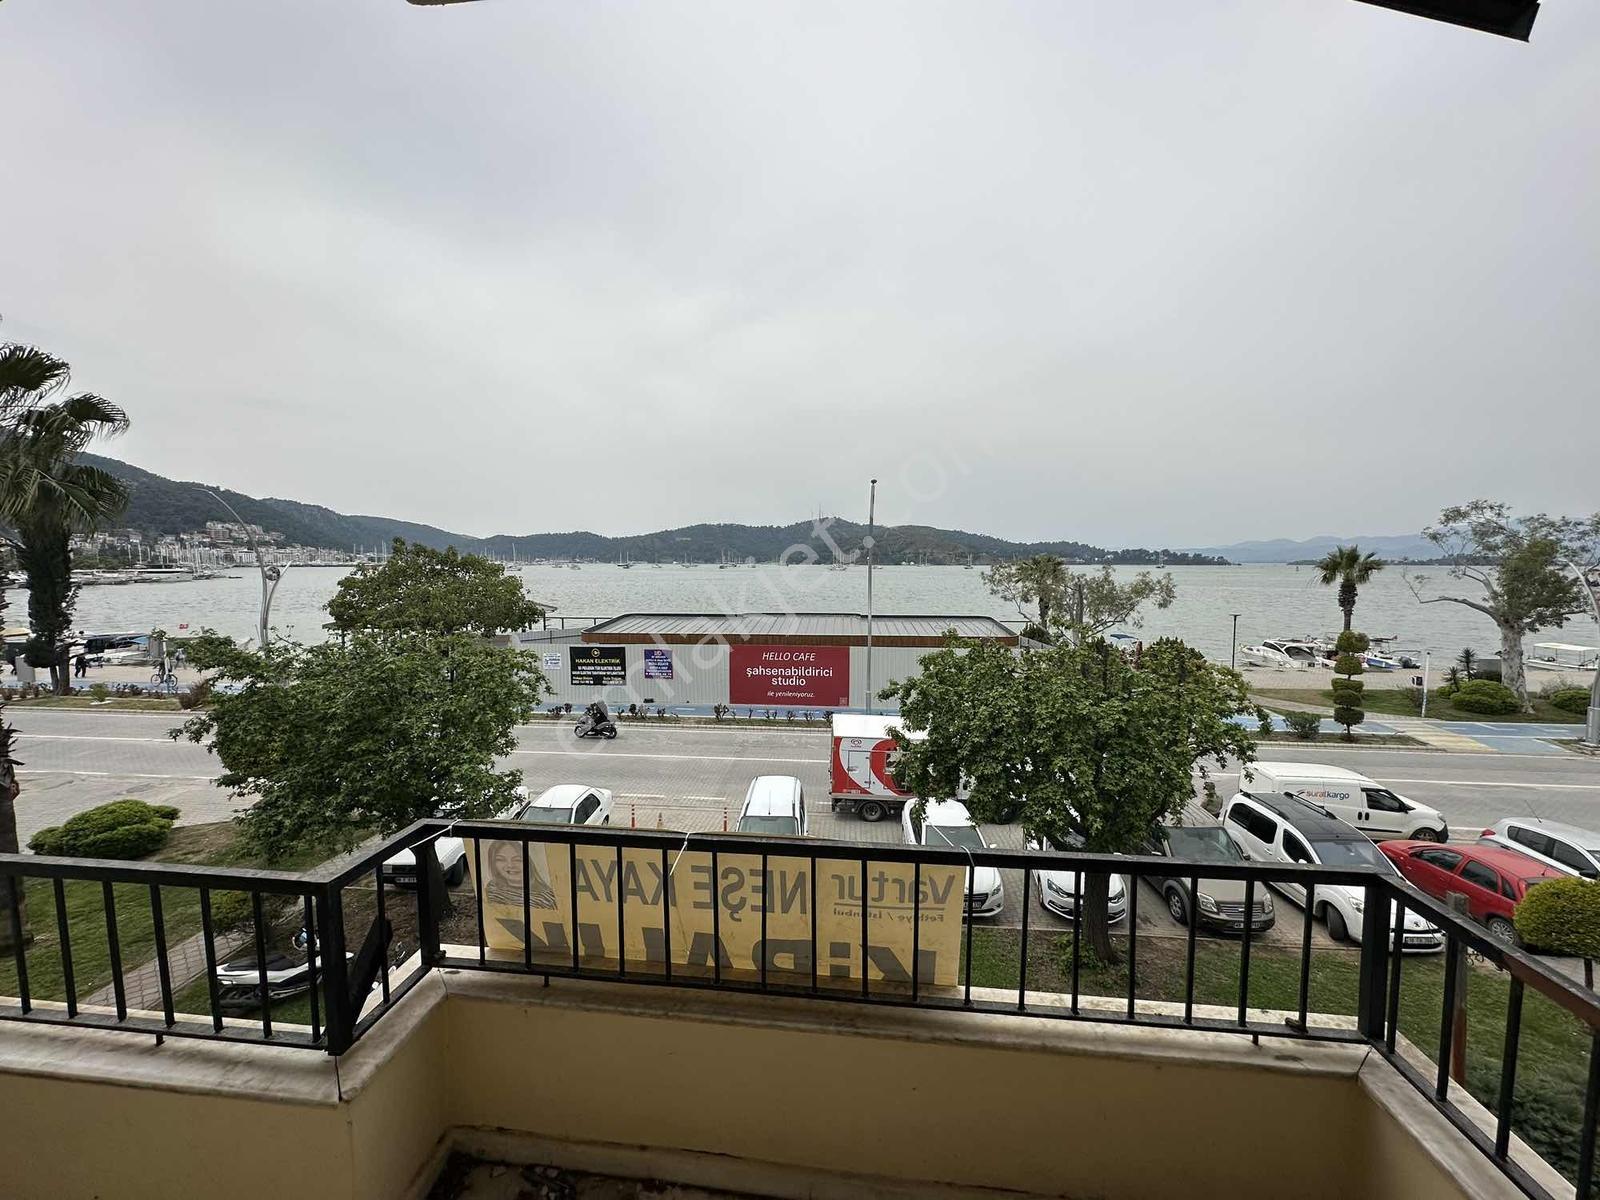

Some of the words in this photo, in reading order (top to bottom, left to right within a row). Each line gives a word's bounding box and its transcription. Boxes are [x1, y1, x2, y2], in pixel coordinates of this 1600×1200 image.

[762, 652, 791, 661] HELLO
[792, 652, 817, 661] CAFE
[746, 665, 833, 678] şahsenabildirici
[771, 676, 806, 686] studio
